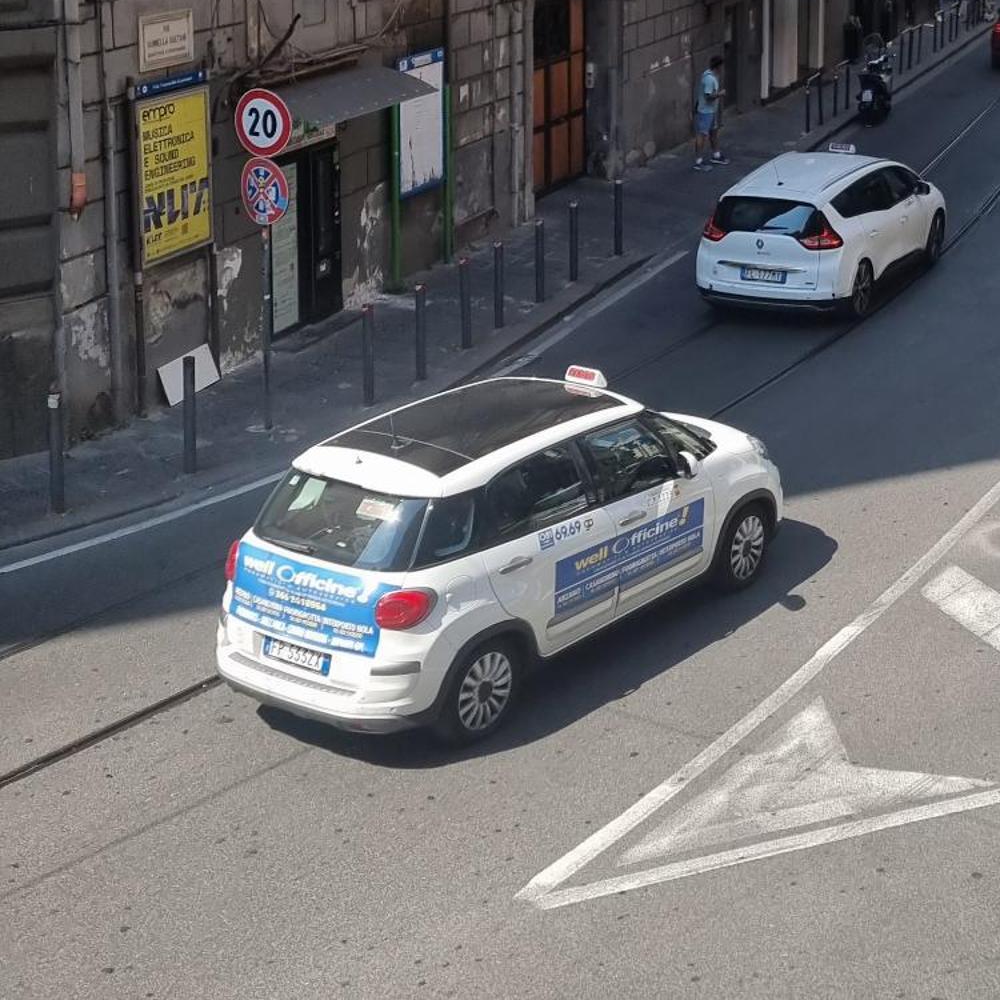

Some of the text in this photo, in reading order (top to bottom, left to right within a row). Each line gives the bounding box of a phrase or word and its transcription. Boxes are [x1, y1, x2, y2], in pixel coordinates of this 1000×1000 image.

[143, 124, 173, 141] MUSICA
[248, 107, 278, 139] 20
[144, 131, 195, 155] ELETTRONICA
[144, 149, 180, 167] E SOUND
[145, 156, 196, 180] ENGINEERING
[243, 554, 276, 576] well
[575, 546, 609, 571] well
